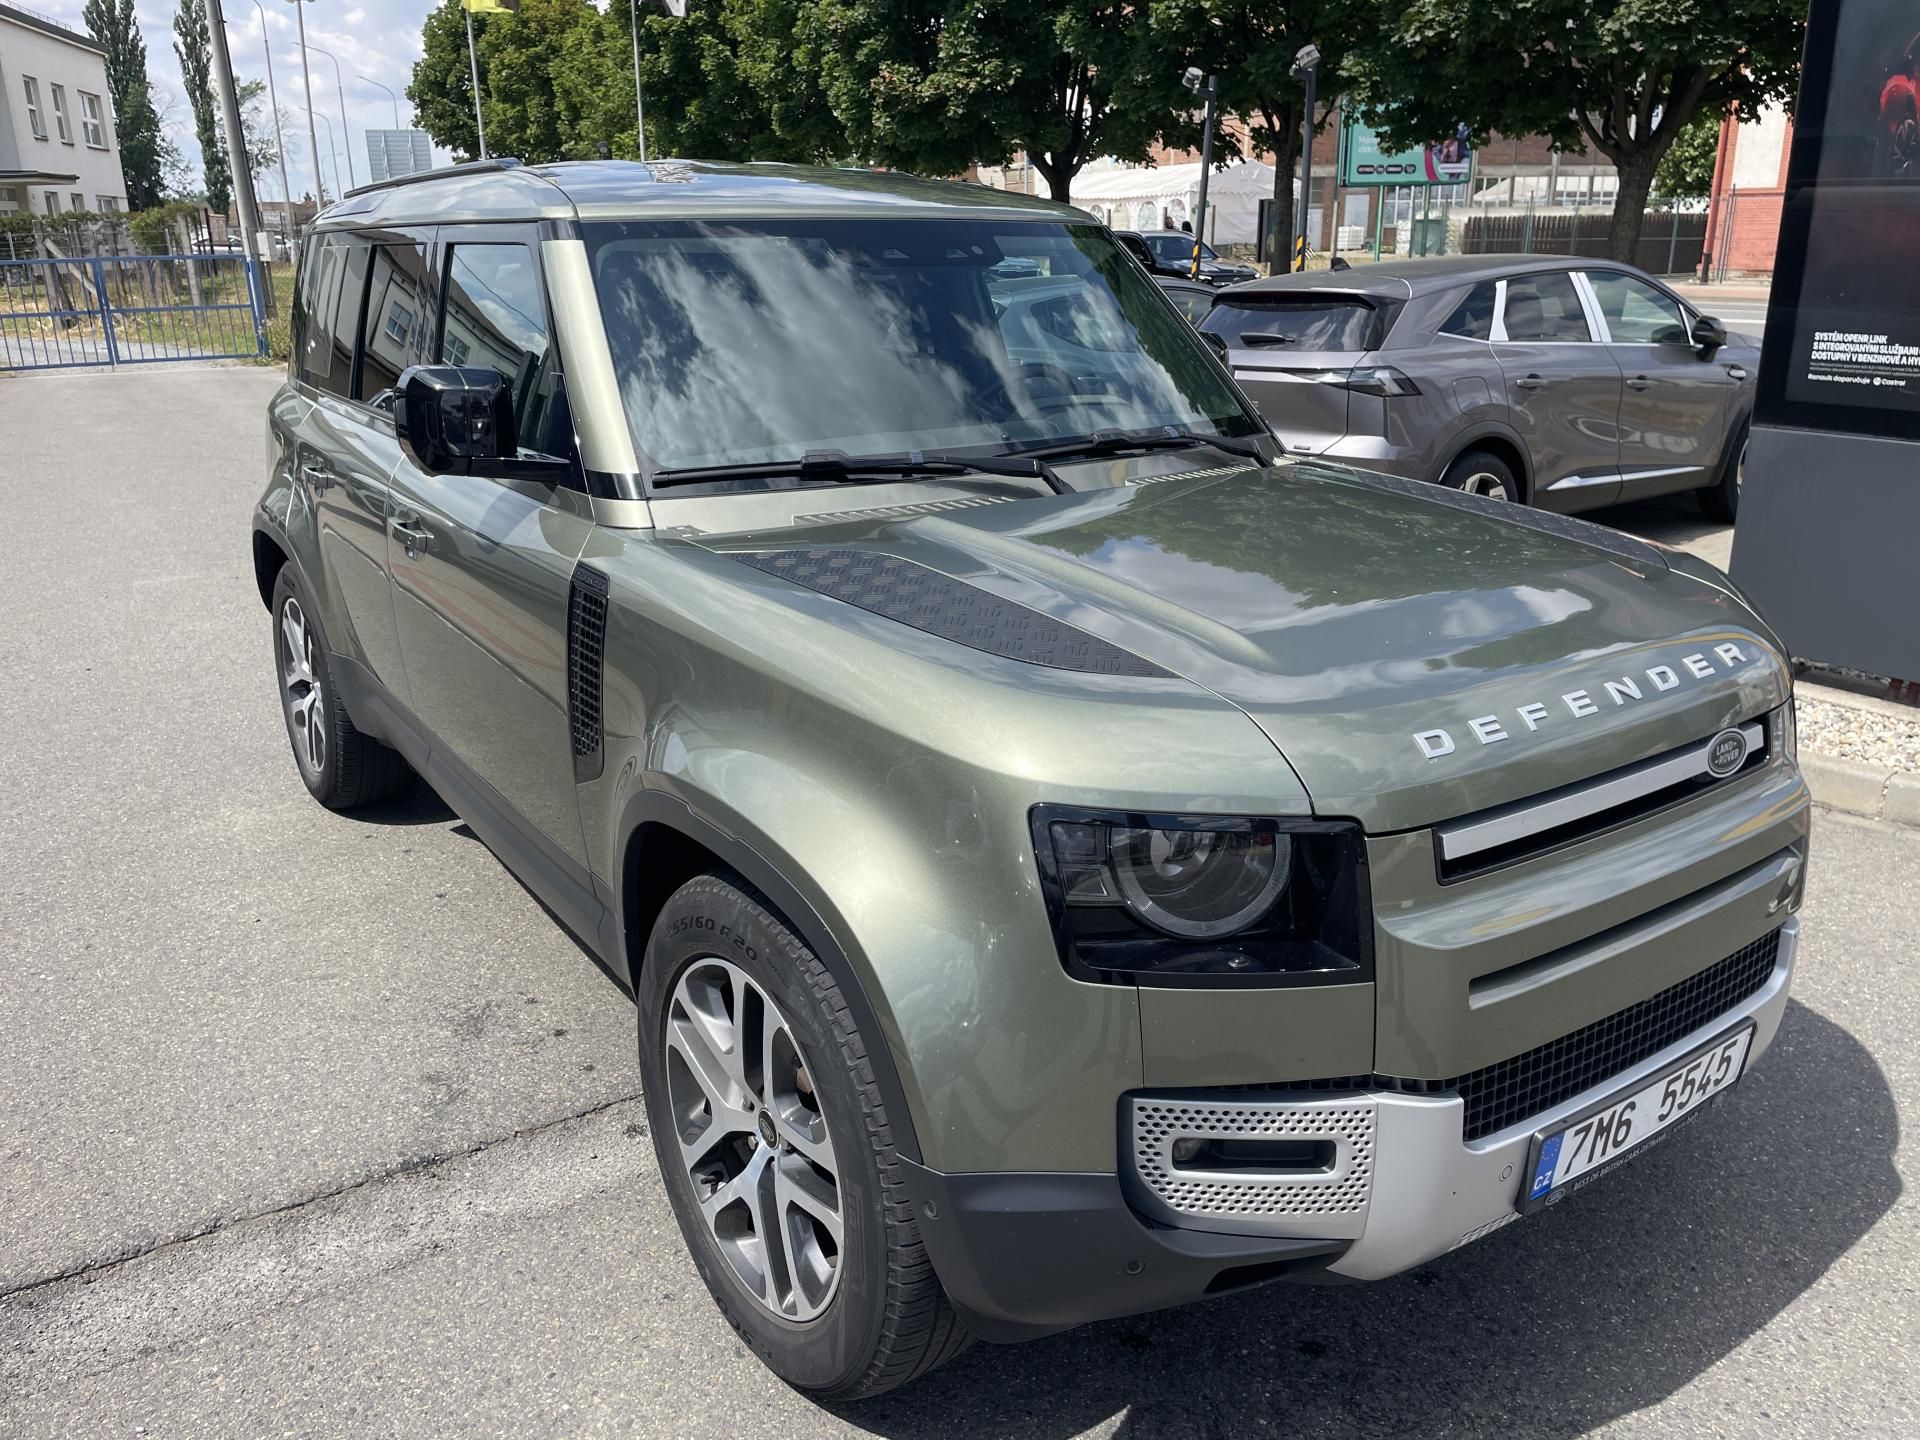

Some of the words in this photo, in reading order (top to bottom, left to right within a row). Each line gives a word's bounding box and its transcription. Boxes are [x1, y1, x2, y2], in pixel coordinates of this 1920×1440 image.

[1814, 331, 1843, 342] SYSTÉM
[1843, 333, 1869, 343] OPENR
[1869, 334, 1888, 344] LINK
[1812, 341, 1818, 350] S
[1818, 341, 1879, 354] INTEGROVANÝMI
[1879, 344, 1919, 356] SLUŽBAMI
[1811, 351, 1851, 361] DOSTUPNÝ
[1851, 353, 1857, 362] V
[1857, 353, 1900, 365] BENZINOVÉ
[1900, 356, 1907, 365] A
[1807, 373, 1833, 381] Renault
[1881, 378, 1906, 387] Castrol
[1412, 642, 1748, 760] DEFENDER
[1716, 741, 1733, 756] LAND
[1718, 748, 1739, 765] ROVER
[1563, 1101, 1636, 1176] 7M6
[1658, 1039, 1738, 1122] 5545
[1534, 1170, 1553, 1191] CZ
